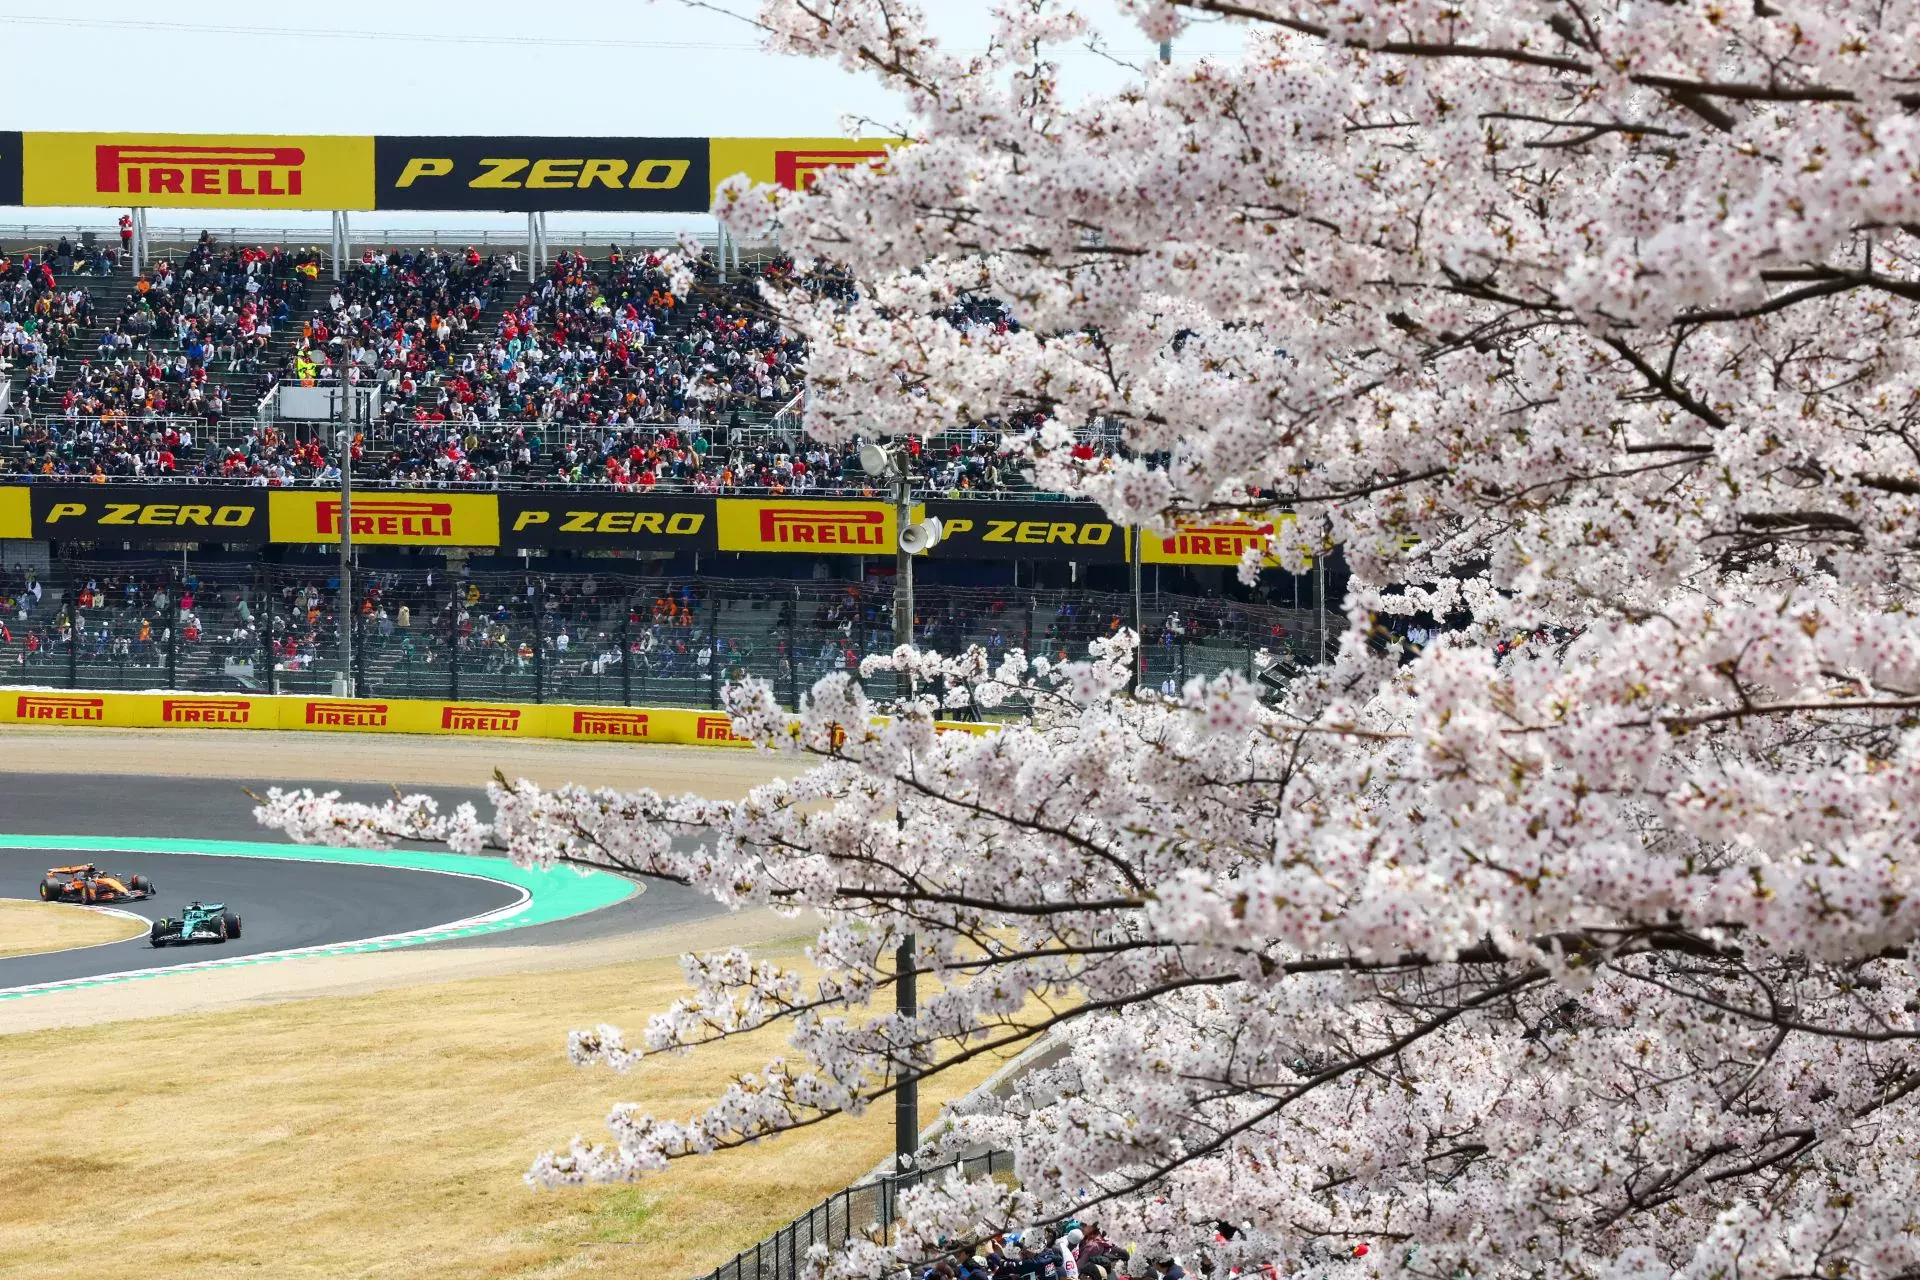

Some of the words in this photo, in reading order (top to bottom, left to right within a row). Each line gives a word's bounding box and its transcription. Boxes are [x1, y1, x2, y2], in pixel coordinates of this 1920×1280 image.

[96, 145, 305, 195] PIRELLI
[395, 158, 454, 187] P
[468, 159, 690, 189] ZERO
[45, 503, 87, 524] P
[97, 504, 255, 527] ZERO
[512, 511, 549, 531] P
[559, 511, 704, 535] ZERO
[760, 508, 884, 545] PIRELLI
[942, 519, 974, 540] P
[982, 520, 1112, 545] ZERO
[17, 696, 104, 721] PIRELLI
[163, 700, 250, 723] PIRELLI
[306, 702, 388, 726] PIRELLI
[441, 706, 521, 731] PIRELLI
[573, 711, 648, 736] PIRELLI
